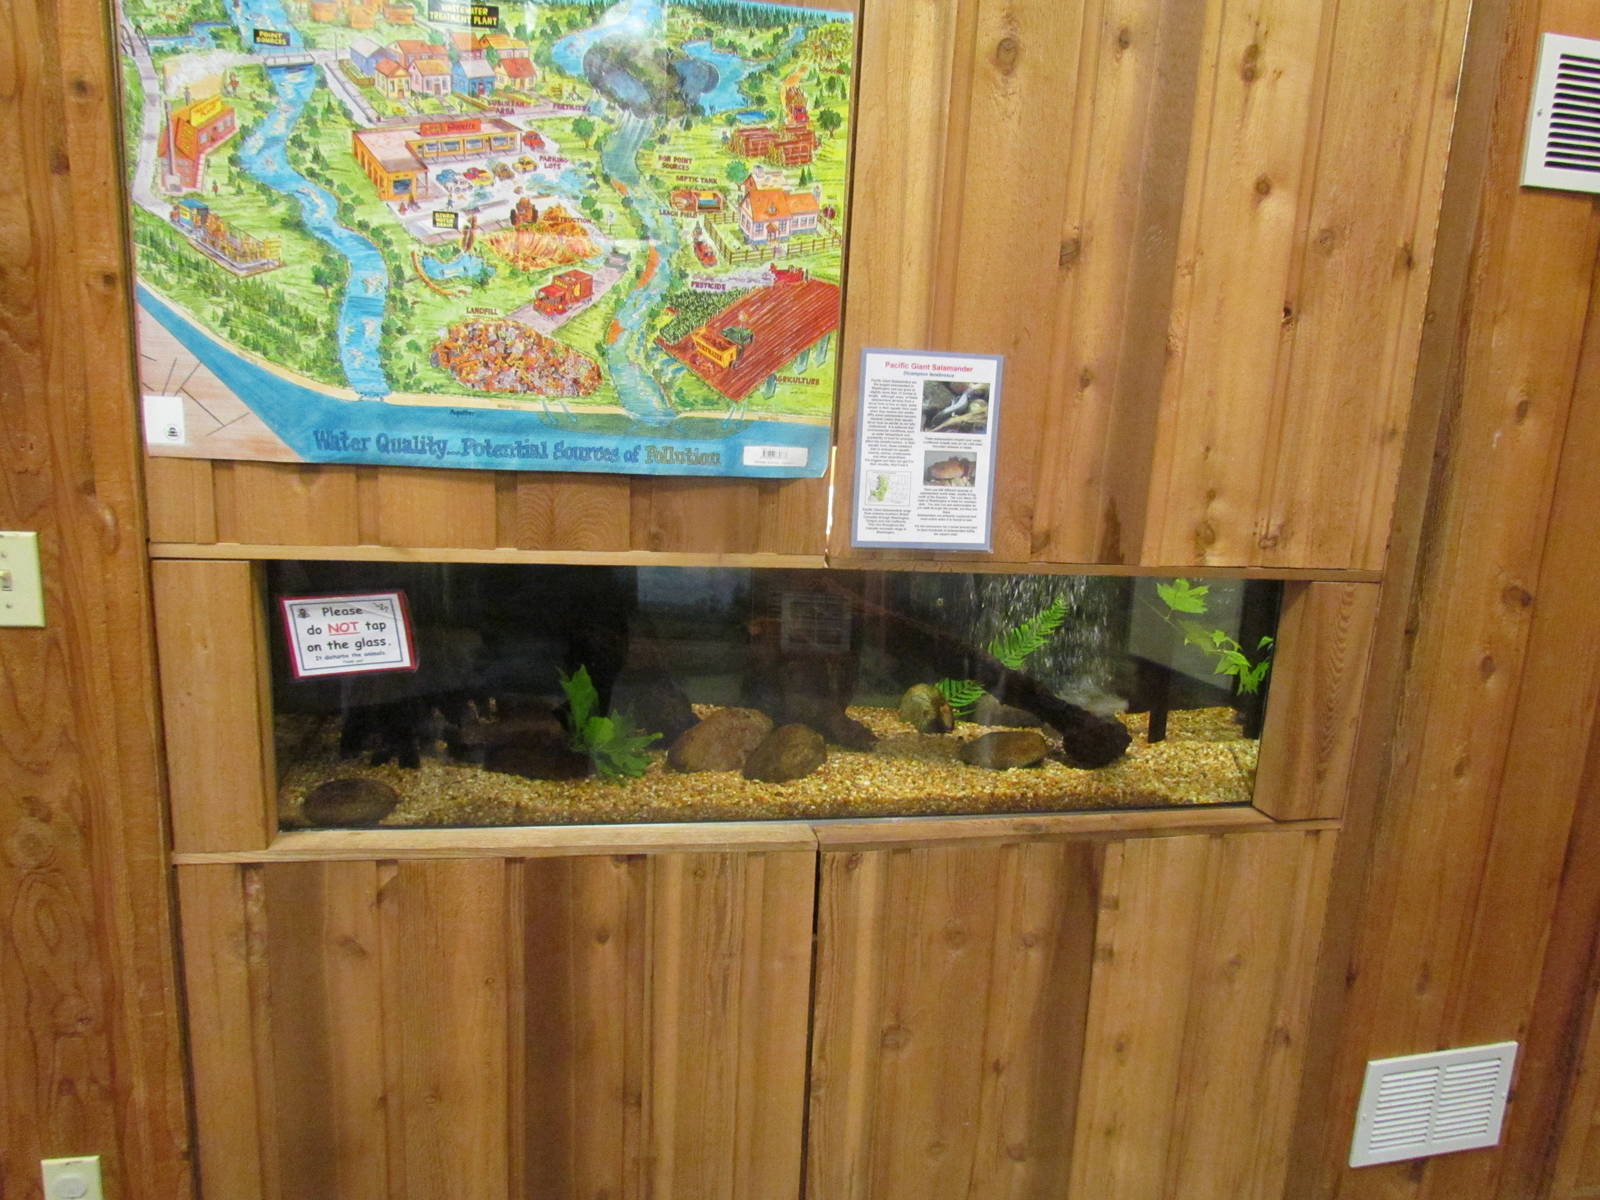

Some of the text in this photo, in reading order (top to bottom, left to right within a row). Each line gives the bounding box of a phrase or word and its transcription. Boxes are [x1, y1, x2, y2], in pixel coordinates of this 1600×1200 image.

[473, 15, 497, 26] PLANT
[466, 306, 498, 315] LANDFILL
[885, 361, 974, 373] Pacific Giant Salamander
[313, 430, 371, 451] Water
[553, 439, 619, 463] Sources
[624, 444, 642, 462] of
[645, 444, 721, 465] Pollution
[322, 606, 363, 617] Please
[307, 620, 387, 636] do NOT tap
[307, 637, 392, 653] on the glass.
